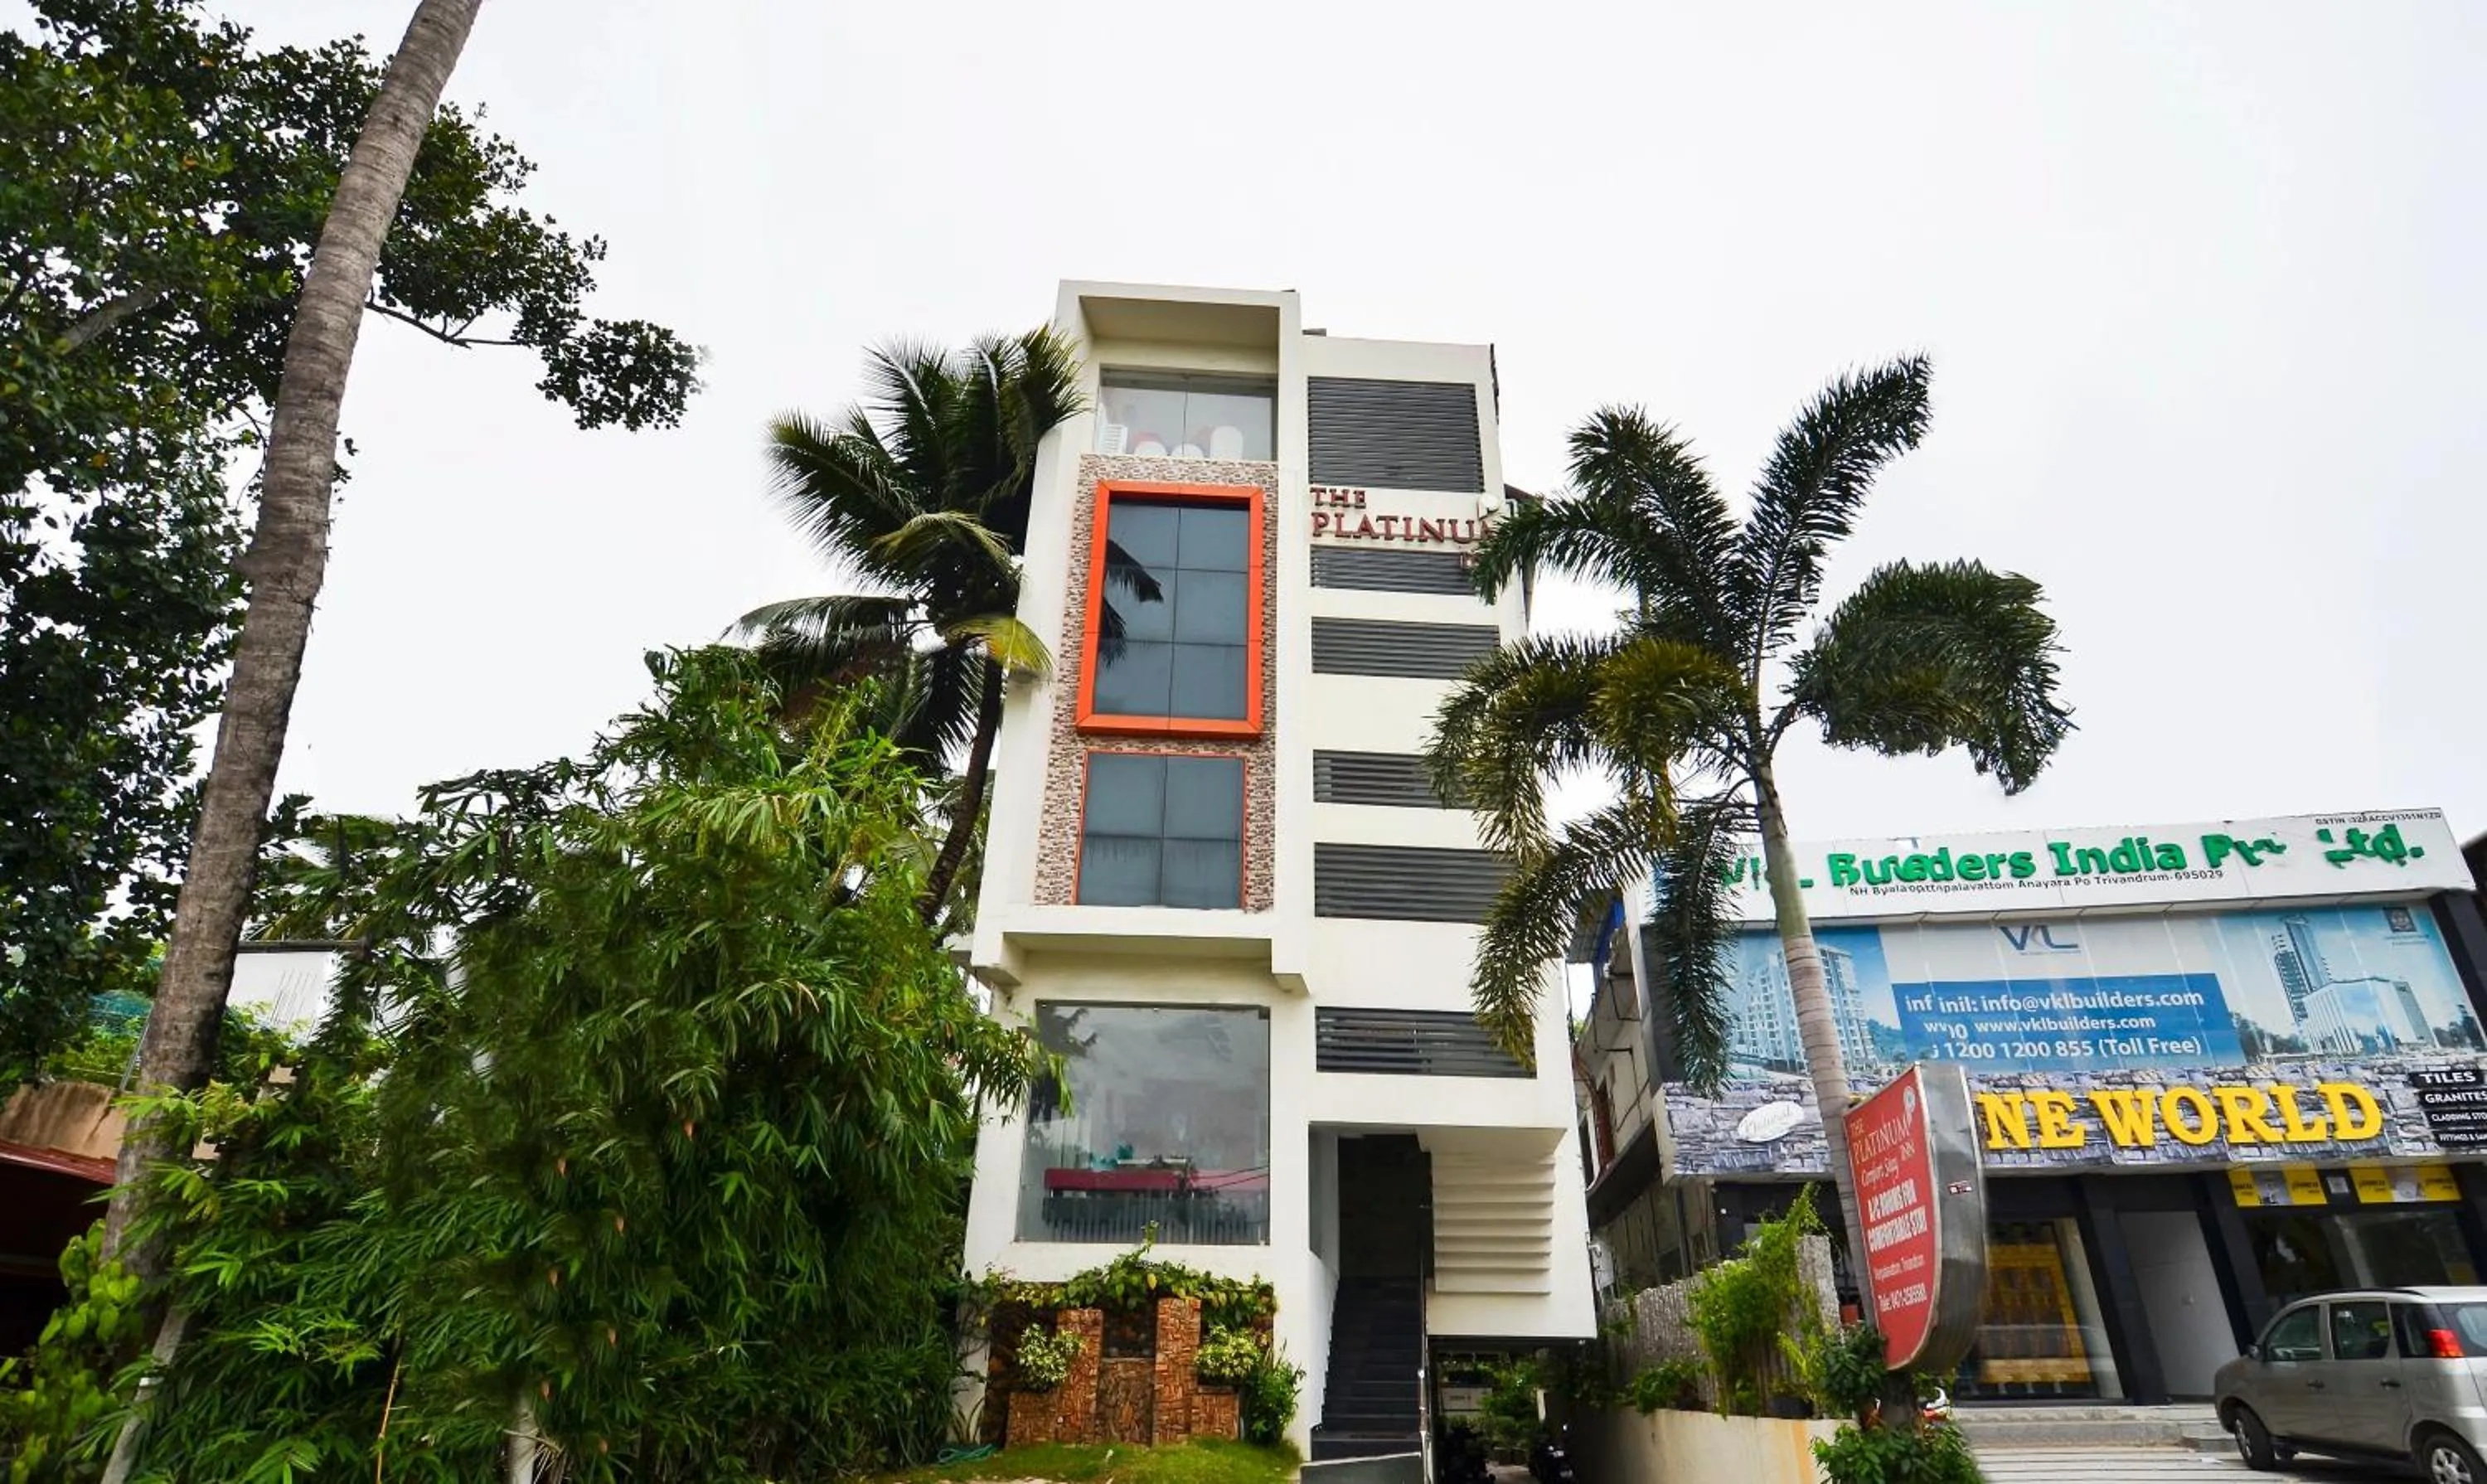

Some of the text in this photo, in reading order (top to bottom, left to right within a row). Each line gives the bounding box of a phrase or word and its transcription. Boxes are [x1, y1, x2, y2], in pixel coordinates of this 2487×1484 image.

[1310, 487, 1366, 509] THE
[2048, 837, 2188, 876] India
[1849, 887, 1868, 897] NH
[1980, 991, 2205, 1013] info@vklbuilders.com
[1974, 1016, 2157, 1033] www.vklbuilders.com
[1944, 1041, 1995, 1059] 1200
[2000, 1040, 2051, 1059] 1200
[2055, 1040, 2094, 1058] 855
[2098, 1037, 2145, 1059] (Toll
[2145, 1035, 2202, 1056] Free)
[2418, 1070, 2477, 1084] TILES
[2424, 1090, 2487, 1104] GRANITES
[2088, 1082, 2384, 1148] WORLD
[1853, 1113, 1911, 1165] PLATINUM
